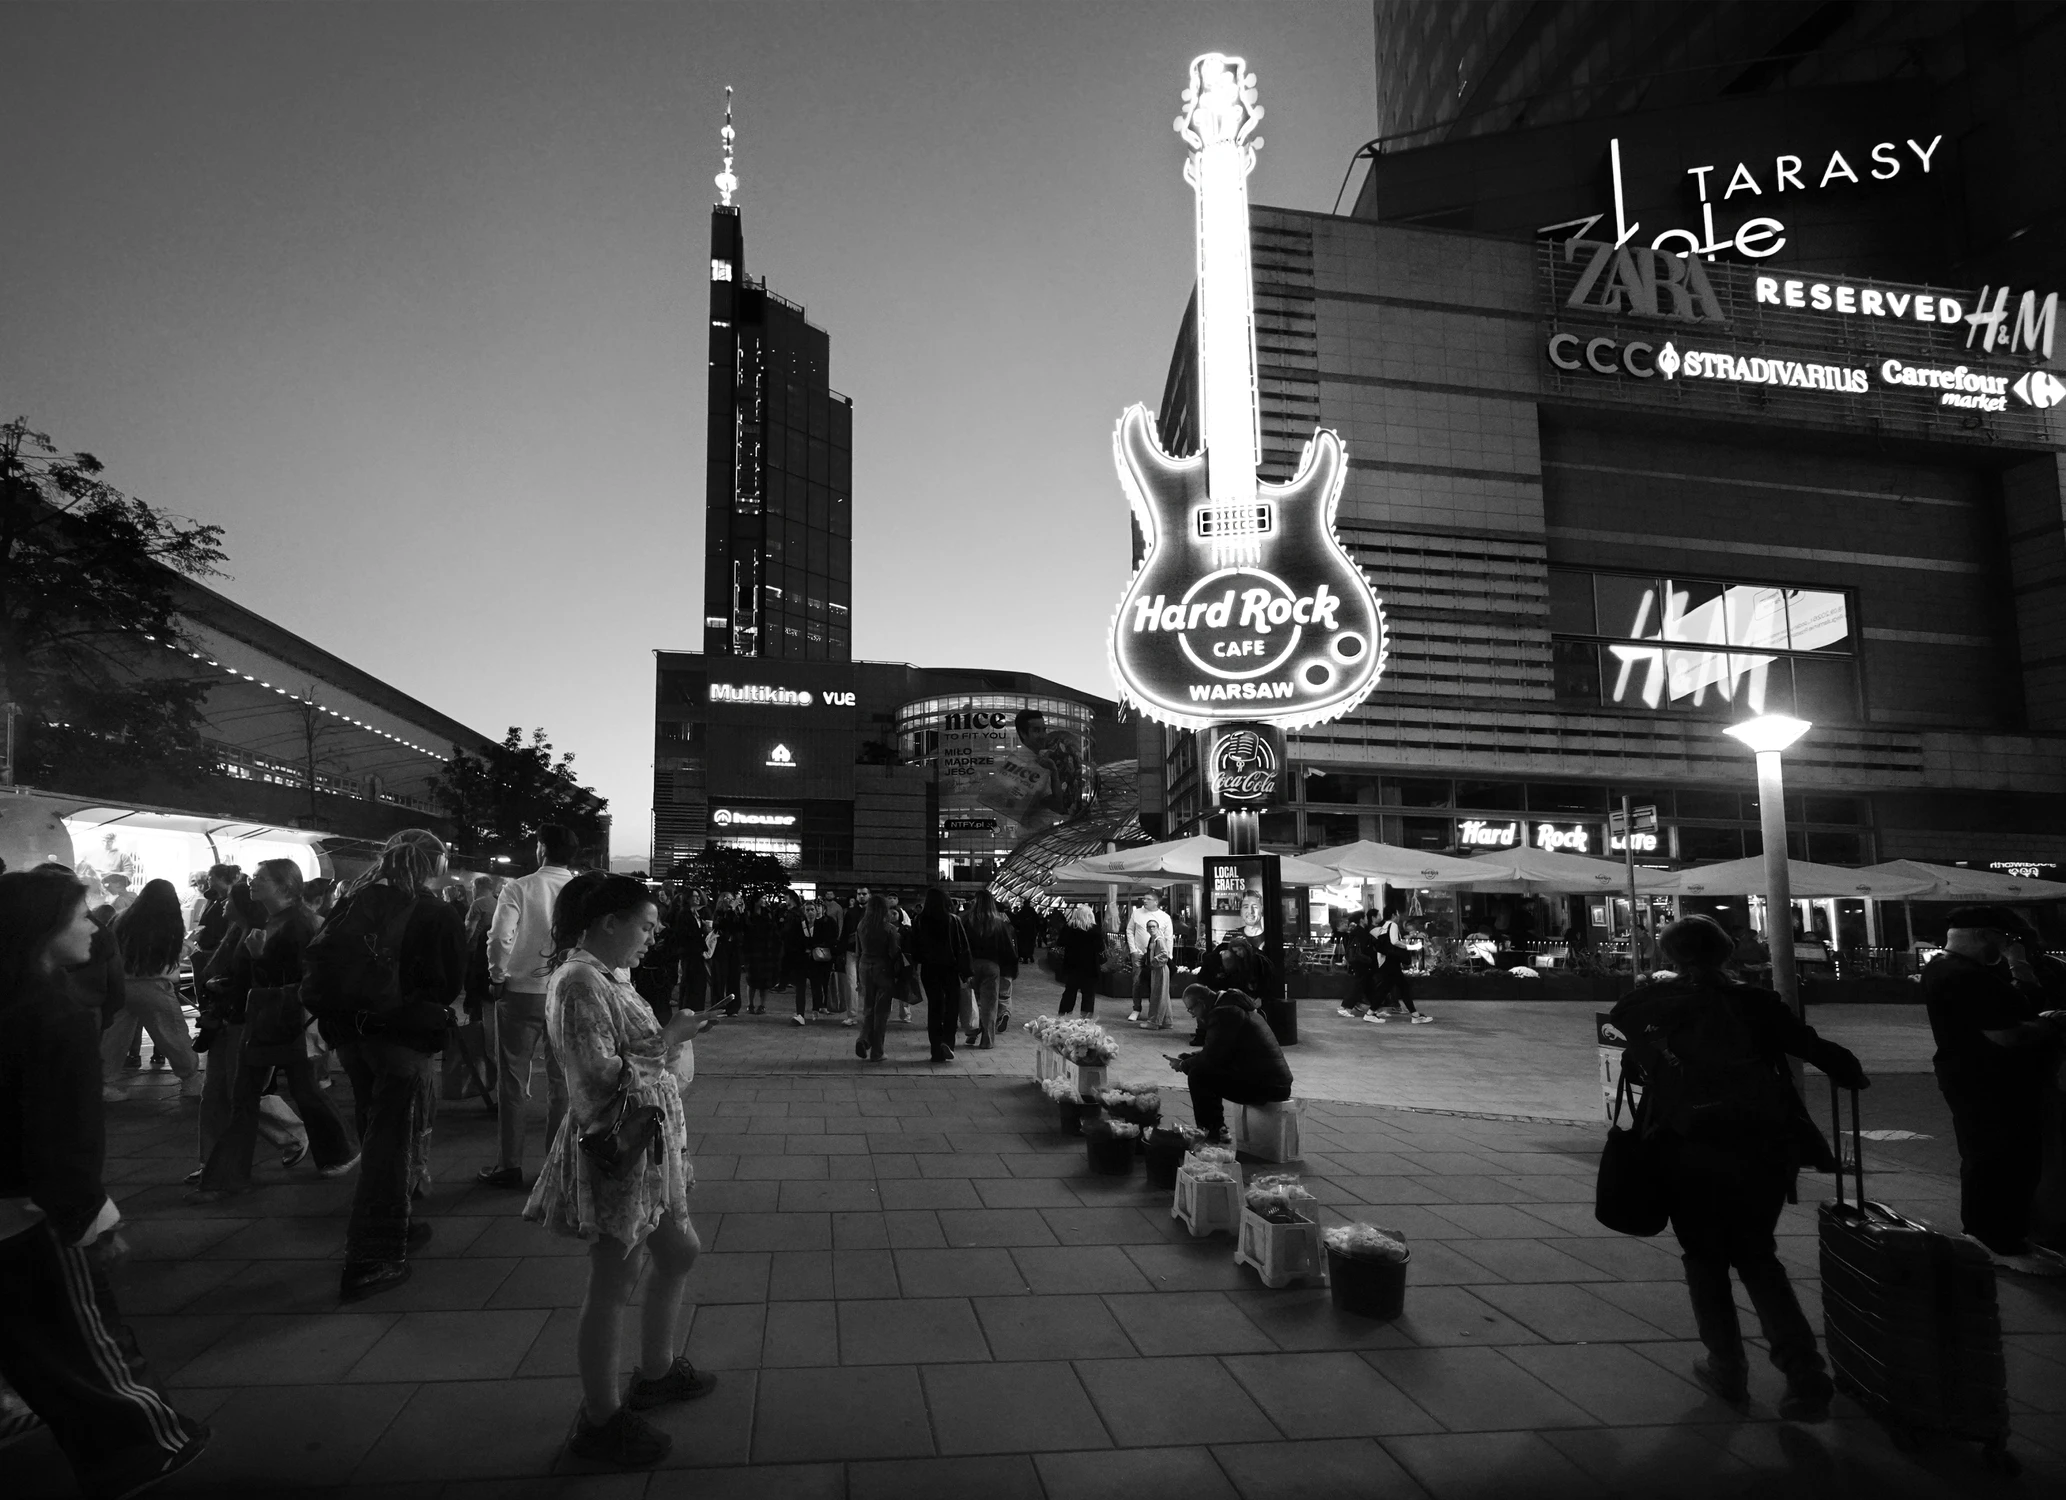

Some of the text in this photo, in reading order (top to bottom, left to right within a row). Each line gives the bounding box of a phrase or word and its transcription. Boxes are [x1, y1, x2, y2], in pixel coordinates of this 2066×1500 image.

[1688, 135, 1942, 202] TARASY
[1564, 237, 1734, 324] ZARA
[1756, 277, 1962, 323] RESERVED
[1964, 285, 2059, 359] H&M
[1548, 333, 1655, 378] CCC
[1683, 351, 1869, 393] STRADIVARIUS
[1881, 360, 2009, 395] Carrefour
[1941, 392, 2008, 412] market
[1133, 584, 1340, 634] Hard Rock
[1213, 640, 1266, 657] CAFE
[710, 684, 856, 706] Multikino vue
[1189, 682, 1294, 701] WARSAW
[945, 704, 1006, 730] nice
[962, 732, 978, 740] FIT
[983, 731, 1006, 740] YOU
[1211, 771, 1278, 794] Coca-Cola
[1459, 821, 1516, 845] Hard
[1537, 824, 1588, 852] Rock
[1214, 866, 1239, 878] LOCAL
[1214, 878, 1246, 891] CRAFTS
